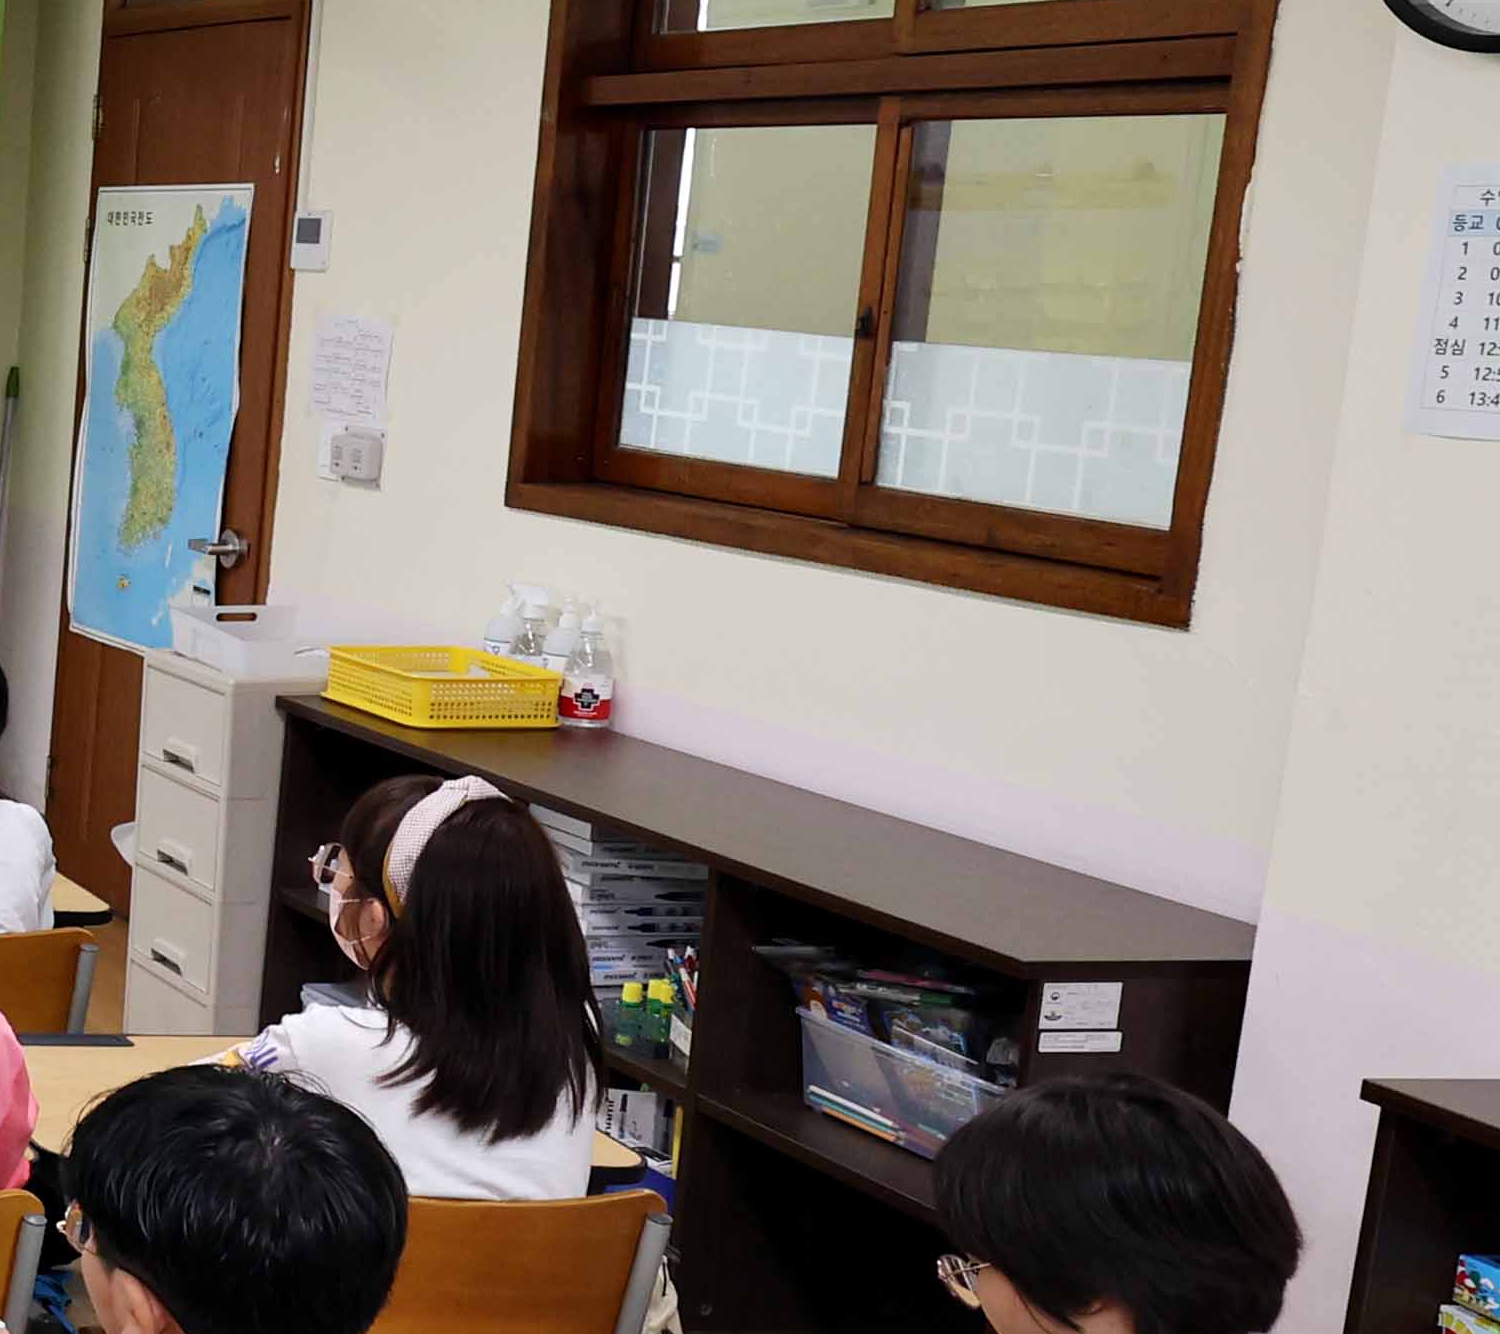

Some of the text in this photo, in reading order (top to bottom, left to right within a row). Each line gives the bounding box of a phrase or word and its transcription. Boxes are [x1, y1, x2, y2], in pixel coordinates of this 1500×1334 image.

[1453, 215, 1484, 232] 등교
[1461, 242, 1469, 255] 1
[1457, 267, 1467, 280] 2
[1453, 292, 1464, 305] 3
[1448, 316, 1459, 328] 4
[1434, 338, 1466, 356] 점심
[1440, 366, 1449, 379] 5
[1436, 390, 1445, 404] 6
